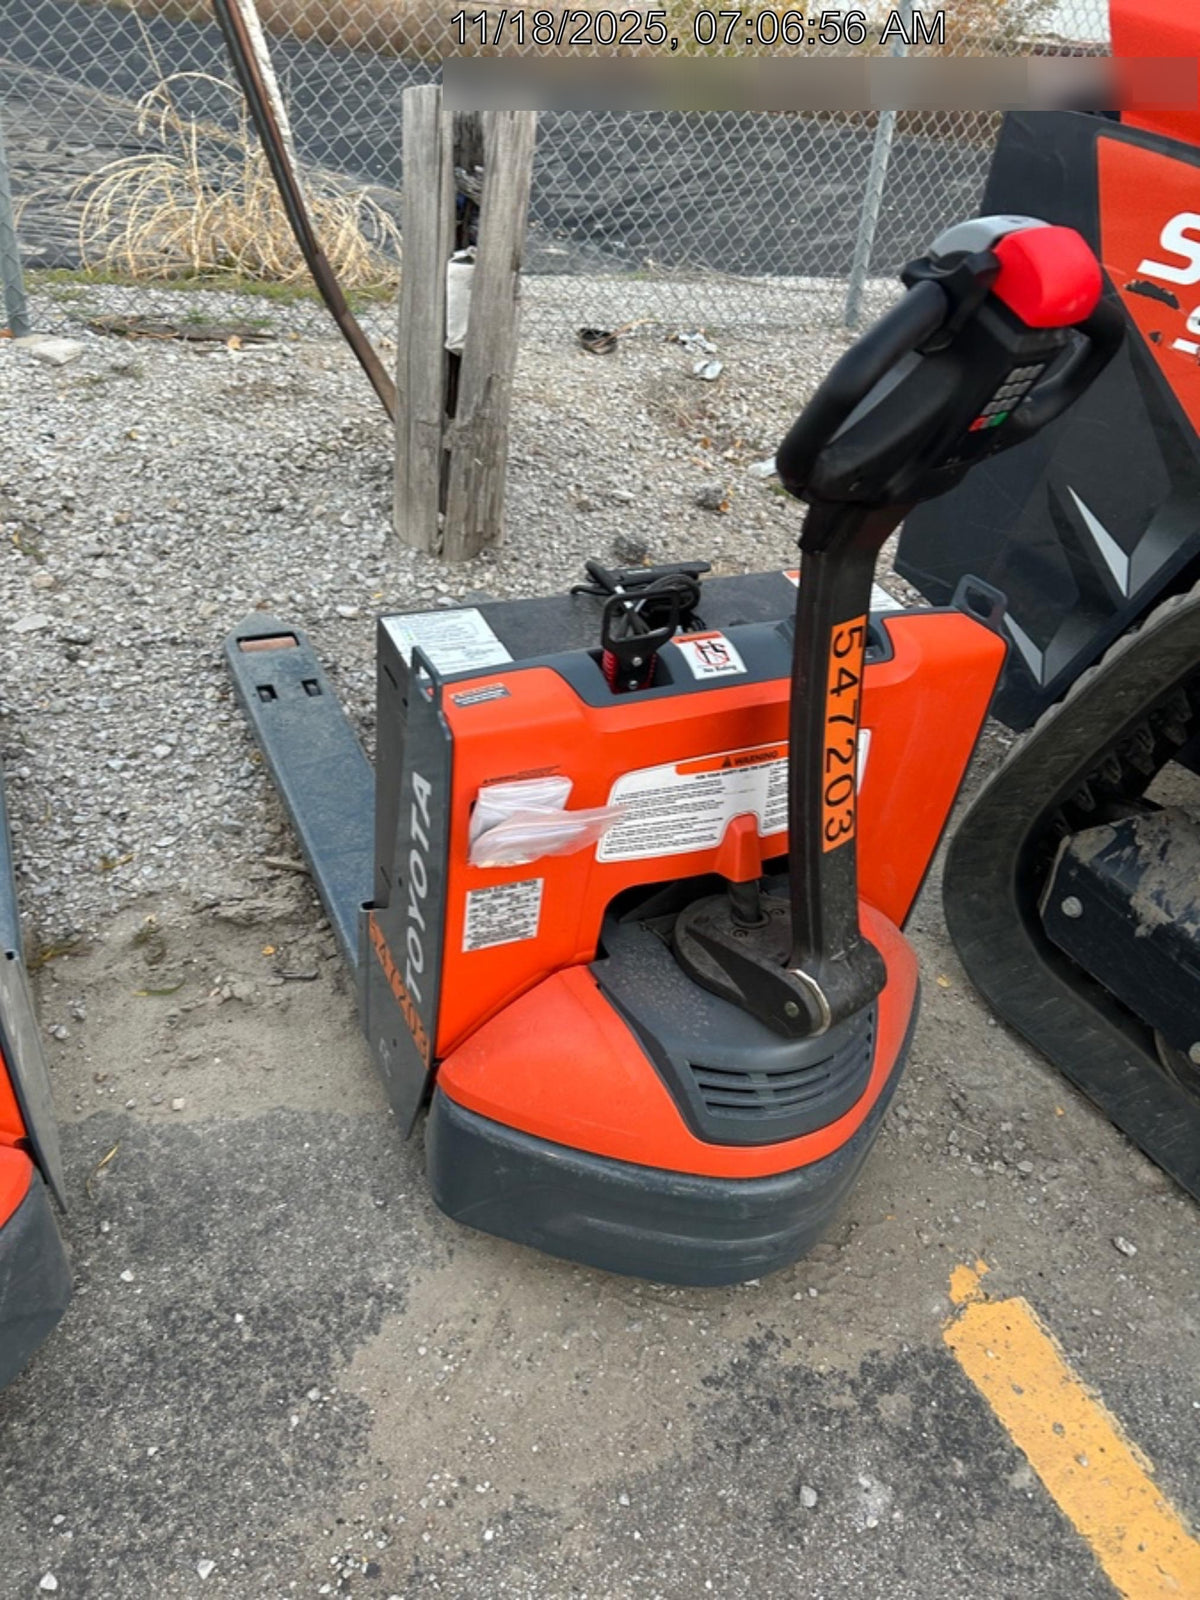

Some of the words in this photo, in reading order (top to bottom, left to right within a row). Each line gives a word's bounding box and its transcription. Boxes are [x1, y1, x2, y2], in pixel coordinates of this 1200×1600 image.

[734, 750, 779, 766] WARNING
[824, 624, 864, 843] 547203
[405, 771, 432, 1004] TOYOTA
